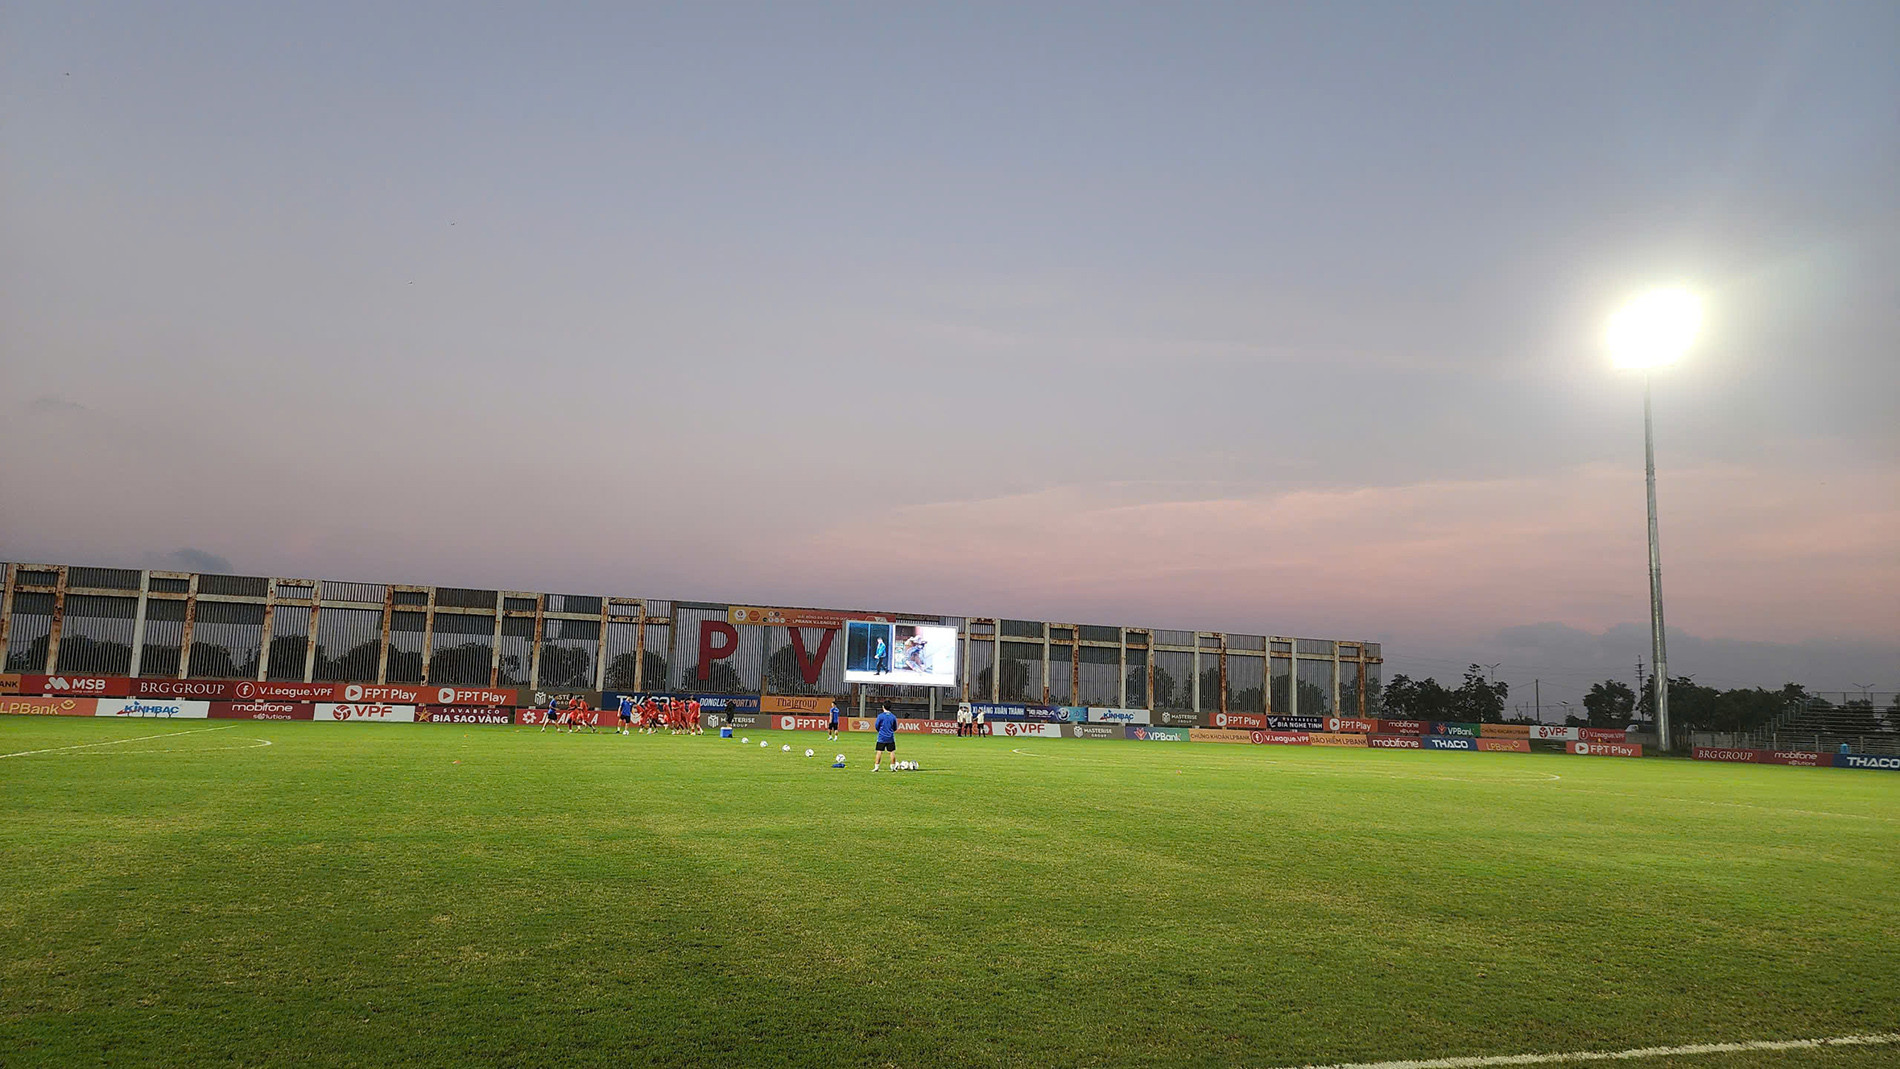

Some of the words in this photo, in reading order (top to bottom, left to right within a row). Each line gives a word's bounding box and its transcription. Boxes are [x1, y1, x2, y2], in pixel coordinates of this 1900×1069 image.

[698, 620, 738, 681] P
[789, 627, 836, 684] V
[72, 679, 106, 690] MSB
[140, 682, 170, 693] BRG
[172, 683, 225, 695] GROUP
[260, 686, 333, 698] V.League.VPF
[364, 688, 389, 699] FPT
[390, 688, 417, 702] Play
[457, 691, 480, 701] FPT
[481, 692, 507, 704] Play
[0, 702, 60, 715] LPBank
[231, 702, 294, 712] mobifone
[354, 705, 393, 717] VPF
[432, 715, 451, 723] BIA
[453, 715, 476, 723] SAO
[478, 714, 508, 724] VÀNG
[797, 719, 817, 729] FPT
[1228, 716, 1243, 725] FPT
[1244, 716, 1261, 727] Play
[897, 722, 920, 731] ANK
[1018, 723, 1045, 734] VPF
[1340, 720, 1355, 729] FPT
[1355, 720, 1372, 732] Play
[1549, 727, 1568, 736] VPF
[1148, 731, 1182, 742] VPBank
[1372, 738, 1419, 748] mobifone
[1431, 739, 1469, 749] THACO
[1590, 745, 1610, 755] FPT
[1611, 746, 1633, 756] Play
[1698, 750, 1718, 759] BRG
[1718, 750, 1753, 760] GROUP
[1774, 751, 1818, 760] mobifone
[1846, 756, 1900, 769] THACO
